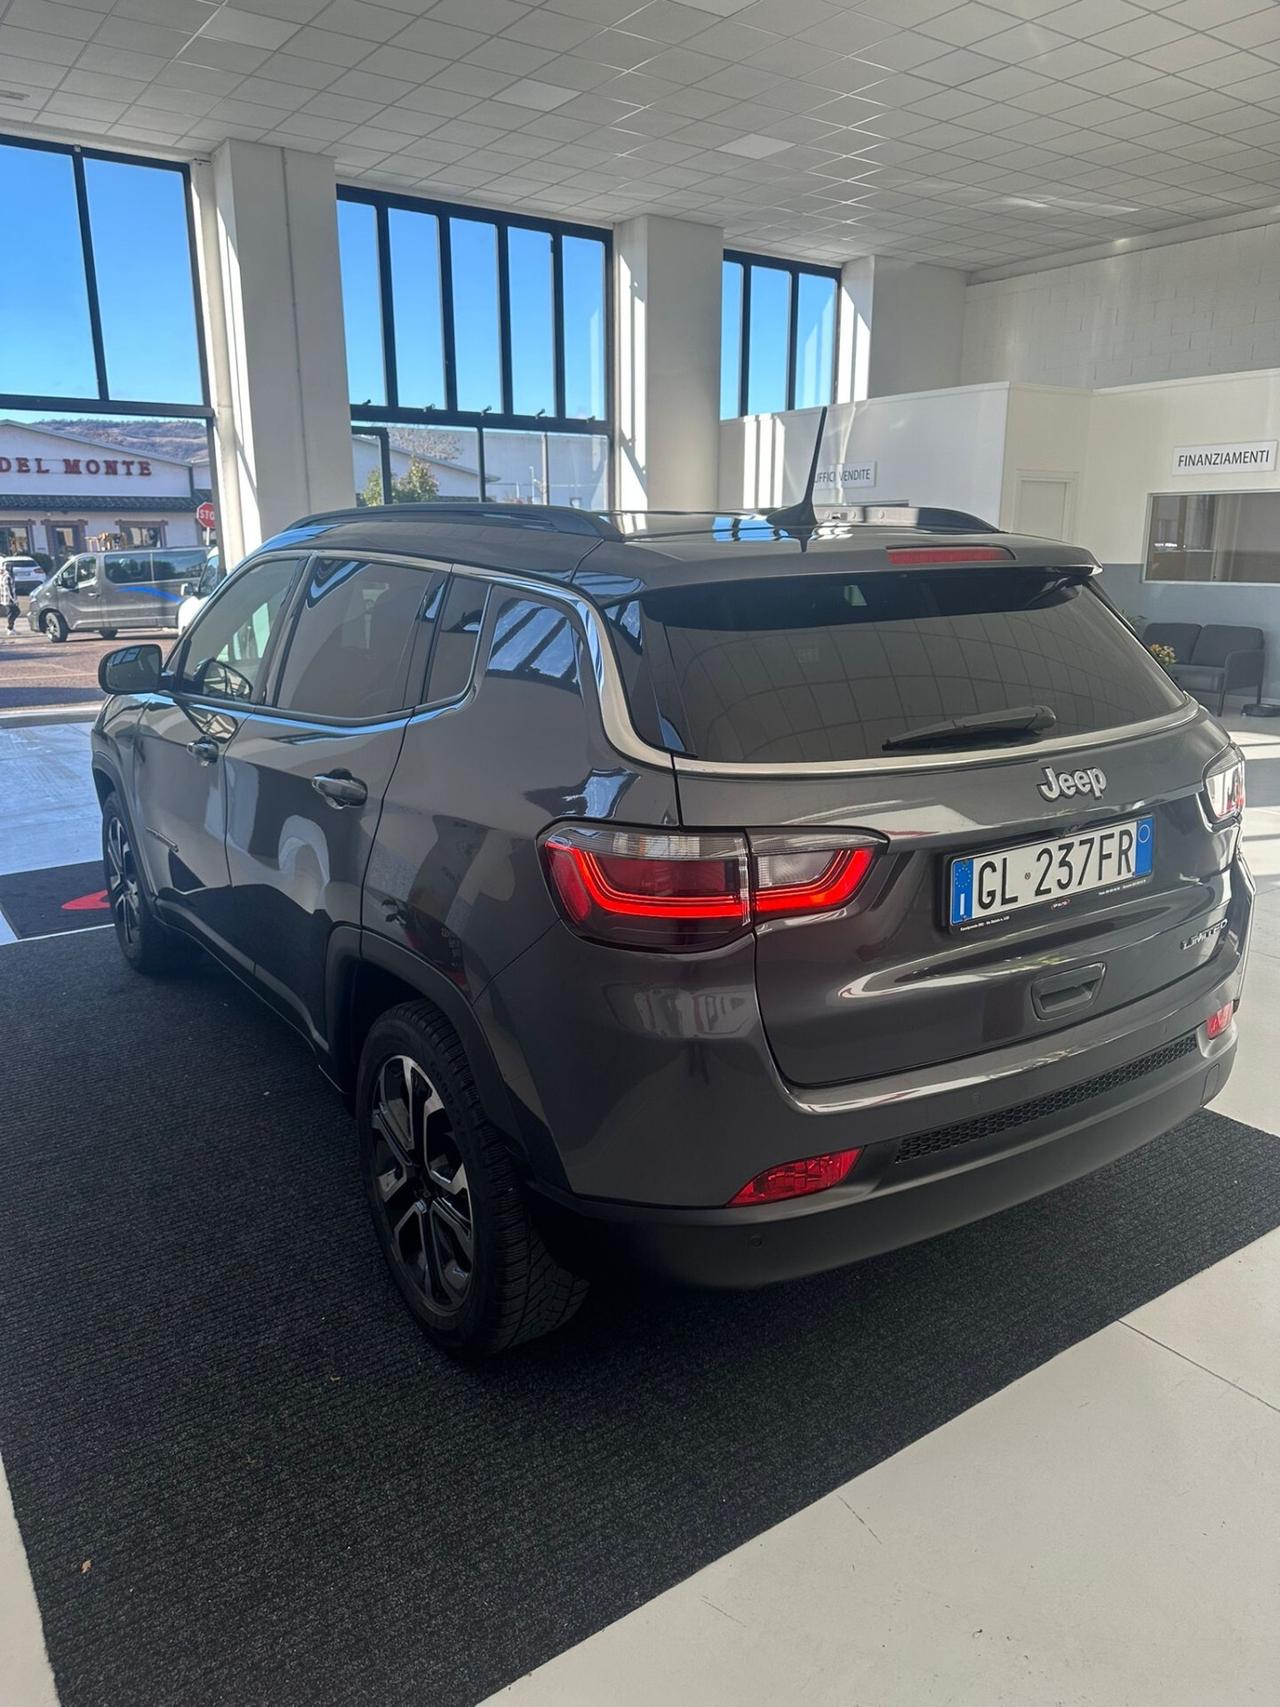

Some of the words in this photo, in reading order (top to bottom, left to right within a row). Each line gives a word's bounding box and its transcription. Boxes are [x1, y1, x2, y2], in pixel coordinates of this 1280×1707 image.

[0, 456, 50, 474] DEL
[62, 458, 152, 476] MONTE
[1177, 449, 1270, 467] FINANZIAMENTI
[838, 468, 871, 482] VENDITE
[199, 508, 216, 521] STO
[1037, 766, 1107, 800] Jeep
[976, 857, 1019, 911] GL
[1034, 828, 1135, 898] 237FR
